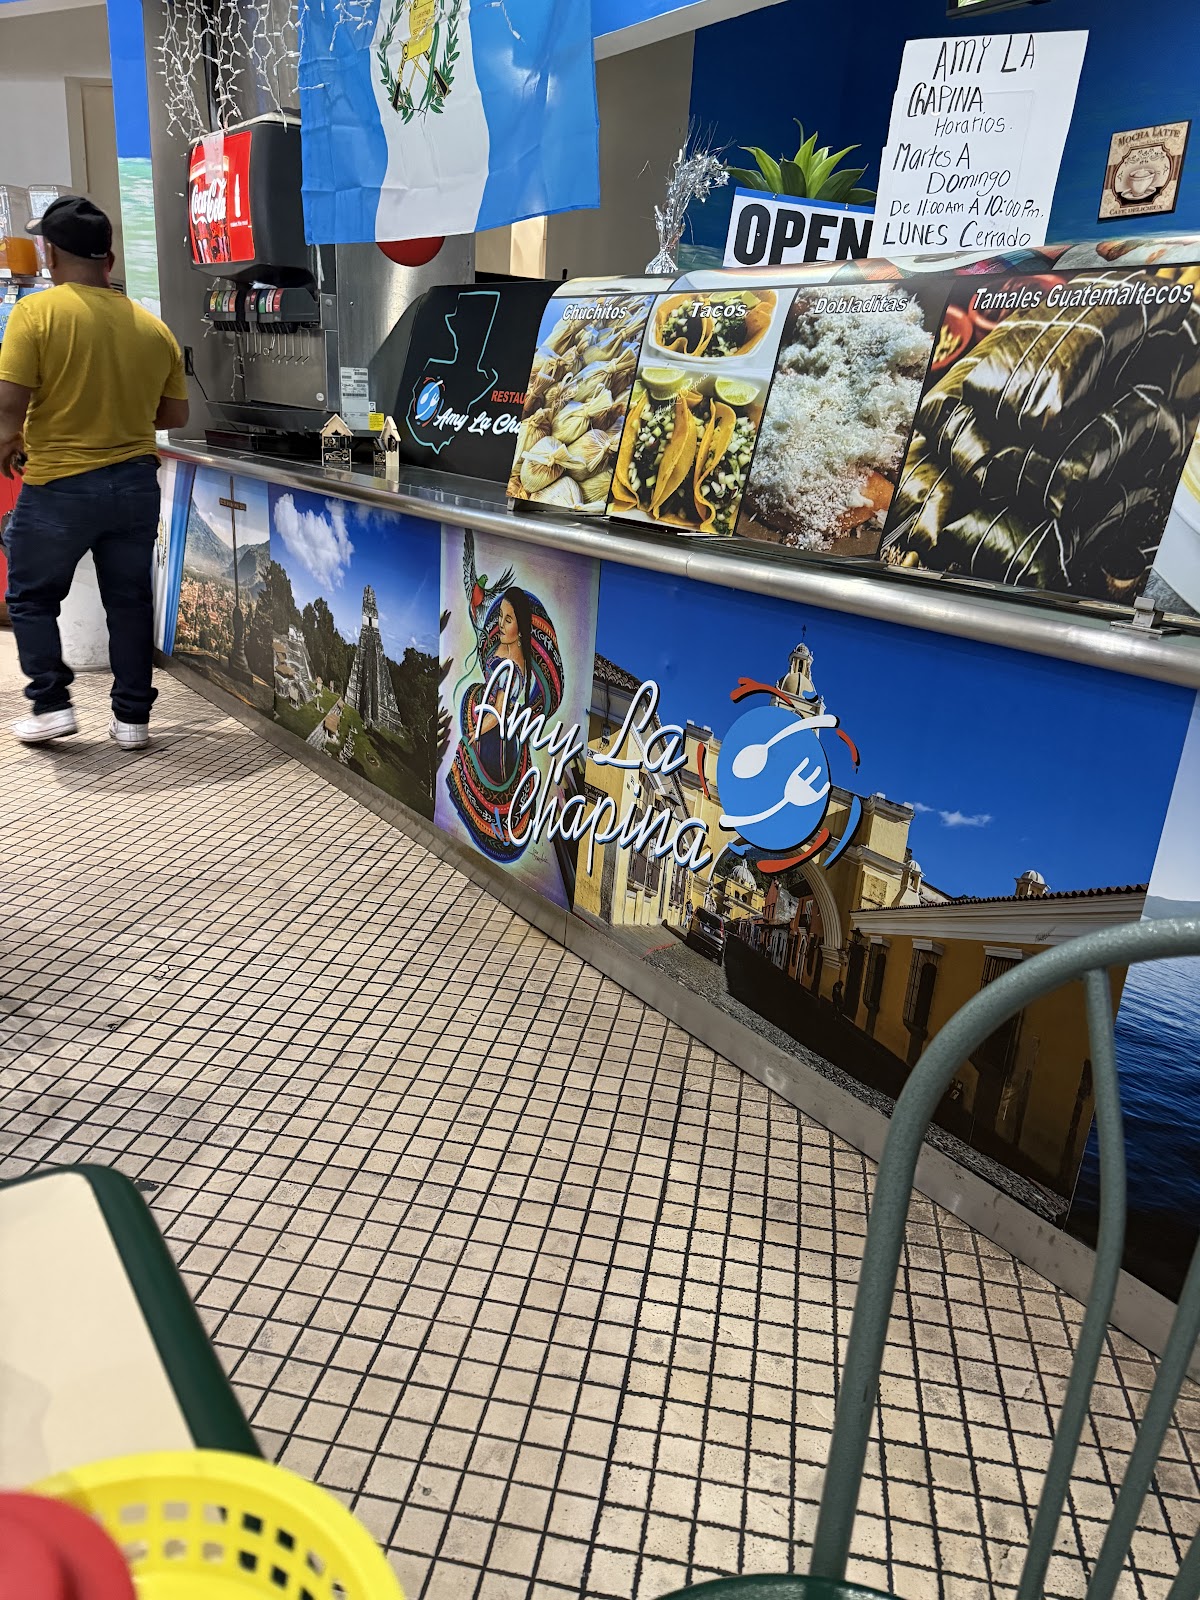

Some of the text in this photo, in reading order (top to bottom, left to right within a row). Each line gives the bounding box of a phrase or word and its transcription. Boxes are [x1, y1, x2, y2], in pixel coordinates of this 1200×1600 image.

[932, 33, 1036, 82] AMY LA
[1118, 131, 1150, 147] MOCHA
[1151, 126, 1181, 138] LATTE
[892, 142, 970, 171] Martes A
[926, 169, 1011, 197] Domingo
[889, 200, 911, 217] De
[969, 199, 980, 216] A
[733, 203, 874, 266] OPEN
[883, 220, 1031, 248] LUNES Cerrado
[814, 293, 909, 315] Dobladitas
[973, 280, 1194, 311] Tamales Guatemaltecos
[562, 302, 629, 321] Chuchitos
[690, 301, 747, 319] Tacos
[433, 408, 470, 432] Amy
[468, 410, 493, 436] La
[474, 658, 690, 784] Amy La
[507, 764, 713, 877] Chapina
